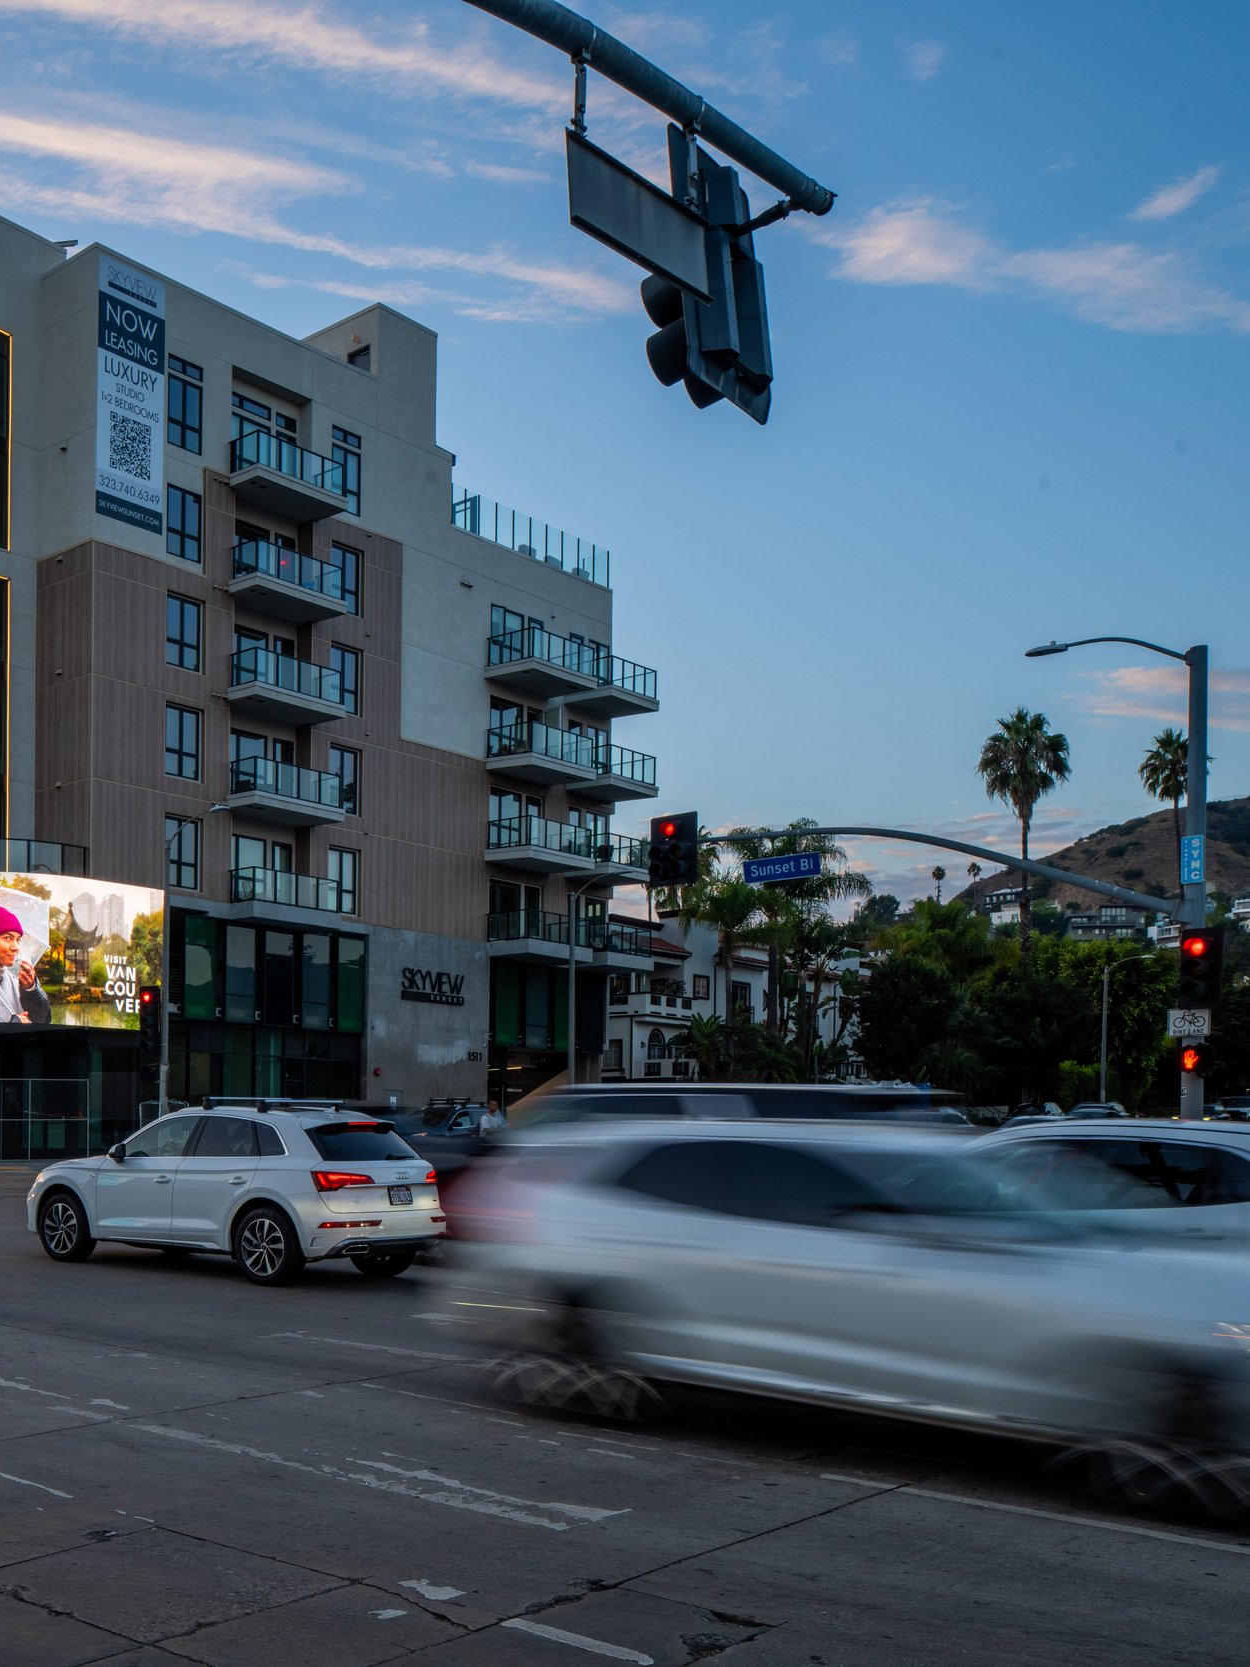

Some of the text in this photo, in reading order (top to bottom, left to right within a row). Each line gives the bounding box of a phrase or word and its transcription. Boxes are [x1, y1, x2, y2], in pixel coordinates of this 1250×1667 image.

[108, 265, 158, 300] SKYVIEW
[106, 300, 158, 341] NOW
[105, 329, 158, 366] LEASING
[104, 355, 158, 393] LUXURY
[116, 382, 145, 403] STUDIO
[114, 396, 160, 423] BEDROOMS
[99, 474, 160, 505] 323.740.6349
[98, 499, 160, 527] SKYVIEWSUNSET.COM
[750, 857, 814, 877] Sunset Bl
[1190, 838, 1200, 880] SYNC
[104, 954, 127, 965] VISIT
[105, 964, 136, 982] VAN
[105, 980, 136, 998] COU
[401, 967, 465, 996] SKYVIEW
[1172, 1028, 1187, 1036] BIKE
[467, 1051, 483, 1062] 1511
